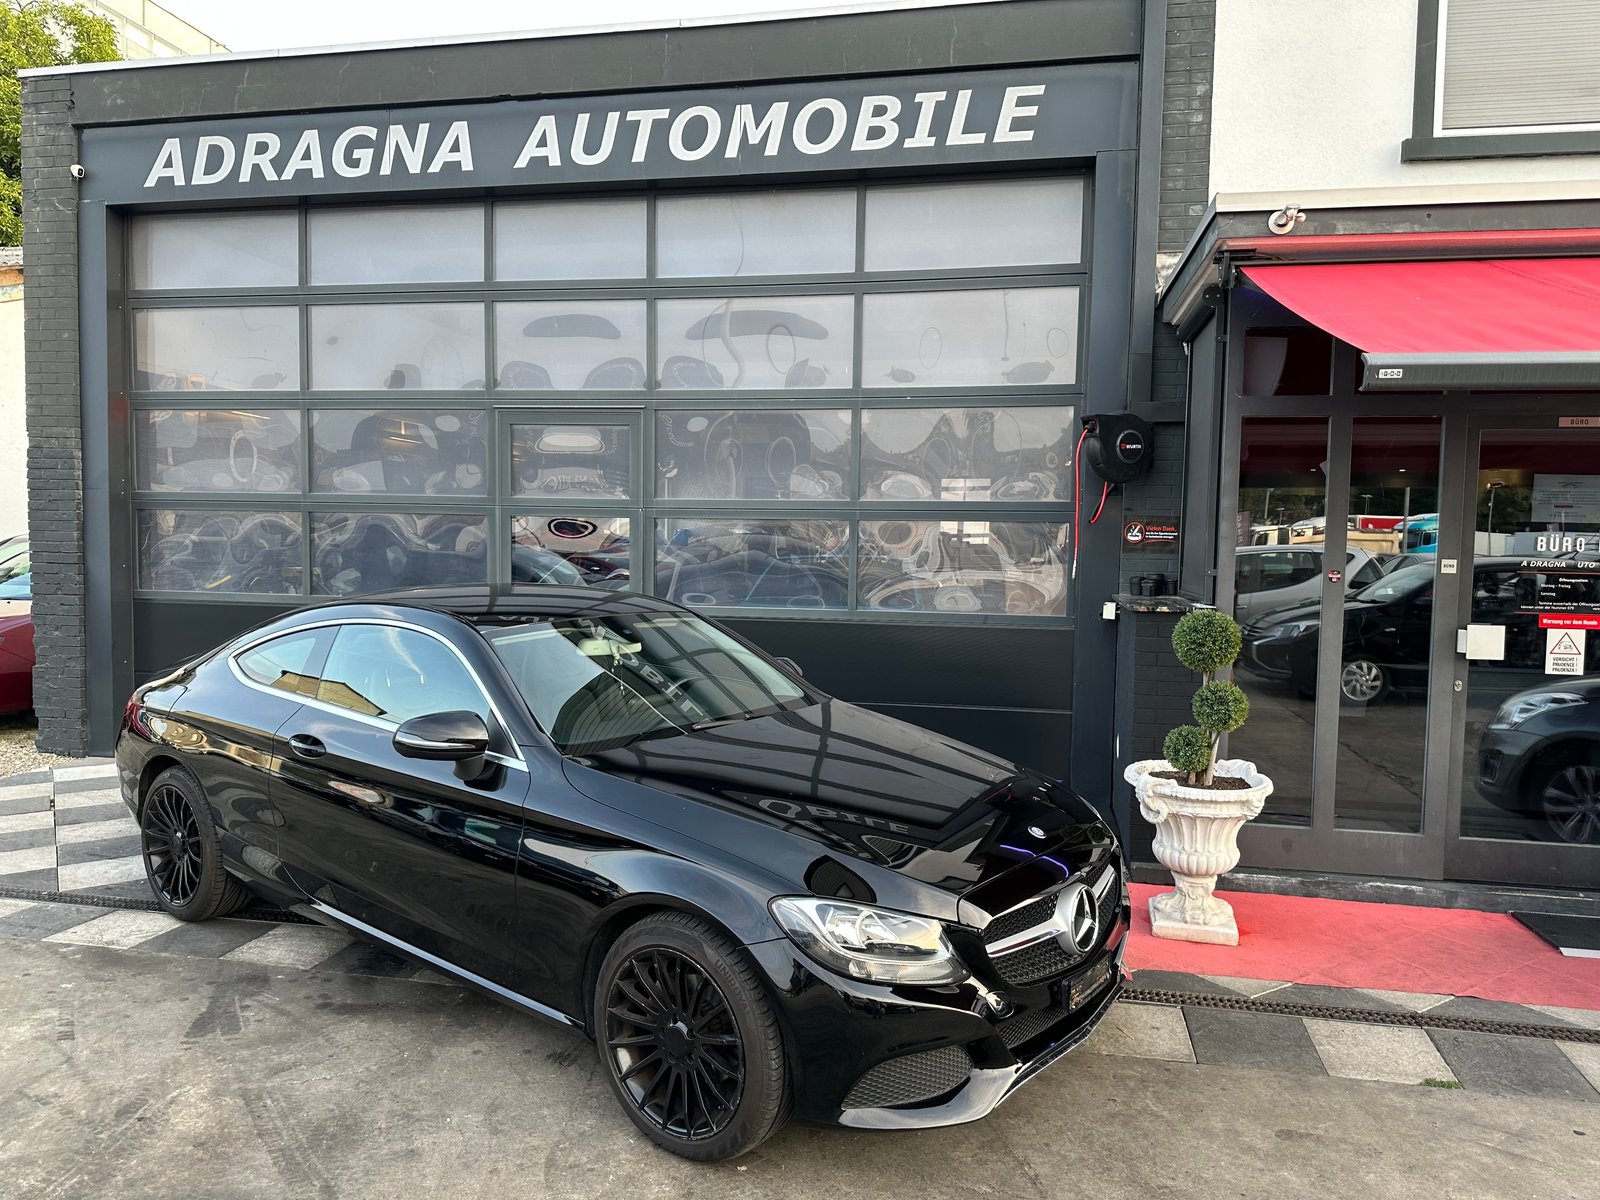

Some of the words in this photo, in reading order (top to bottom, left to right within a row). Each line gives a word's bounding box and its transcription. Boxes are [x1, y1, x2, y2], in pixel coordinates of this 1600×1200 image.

[143, 120, 475, 188] ADRAGNA
[513, 84, 1047, 169] AUTOMOBILE
[1570, 417, 1589, 425] BÜRO
[1537, 534, 1586, 552] BÜRO
